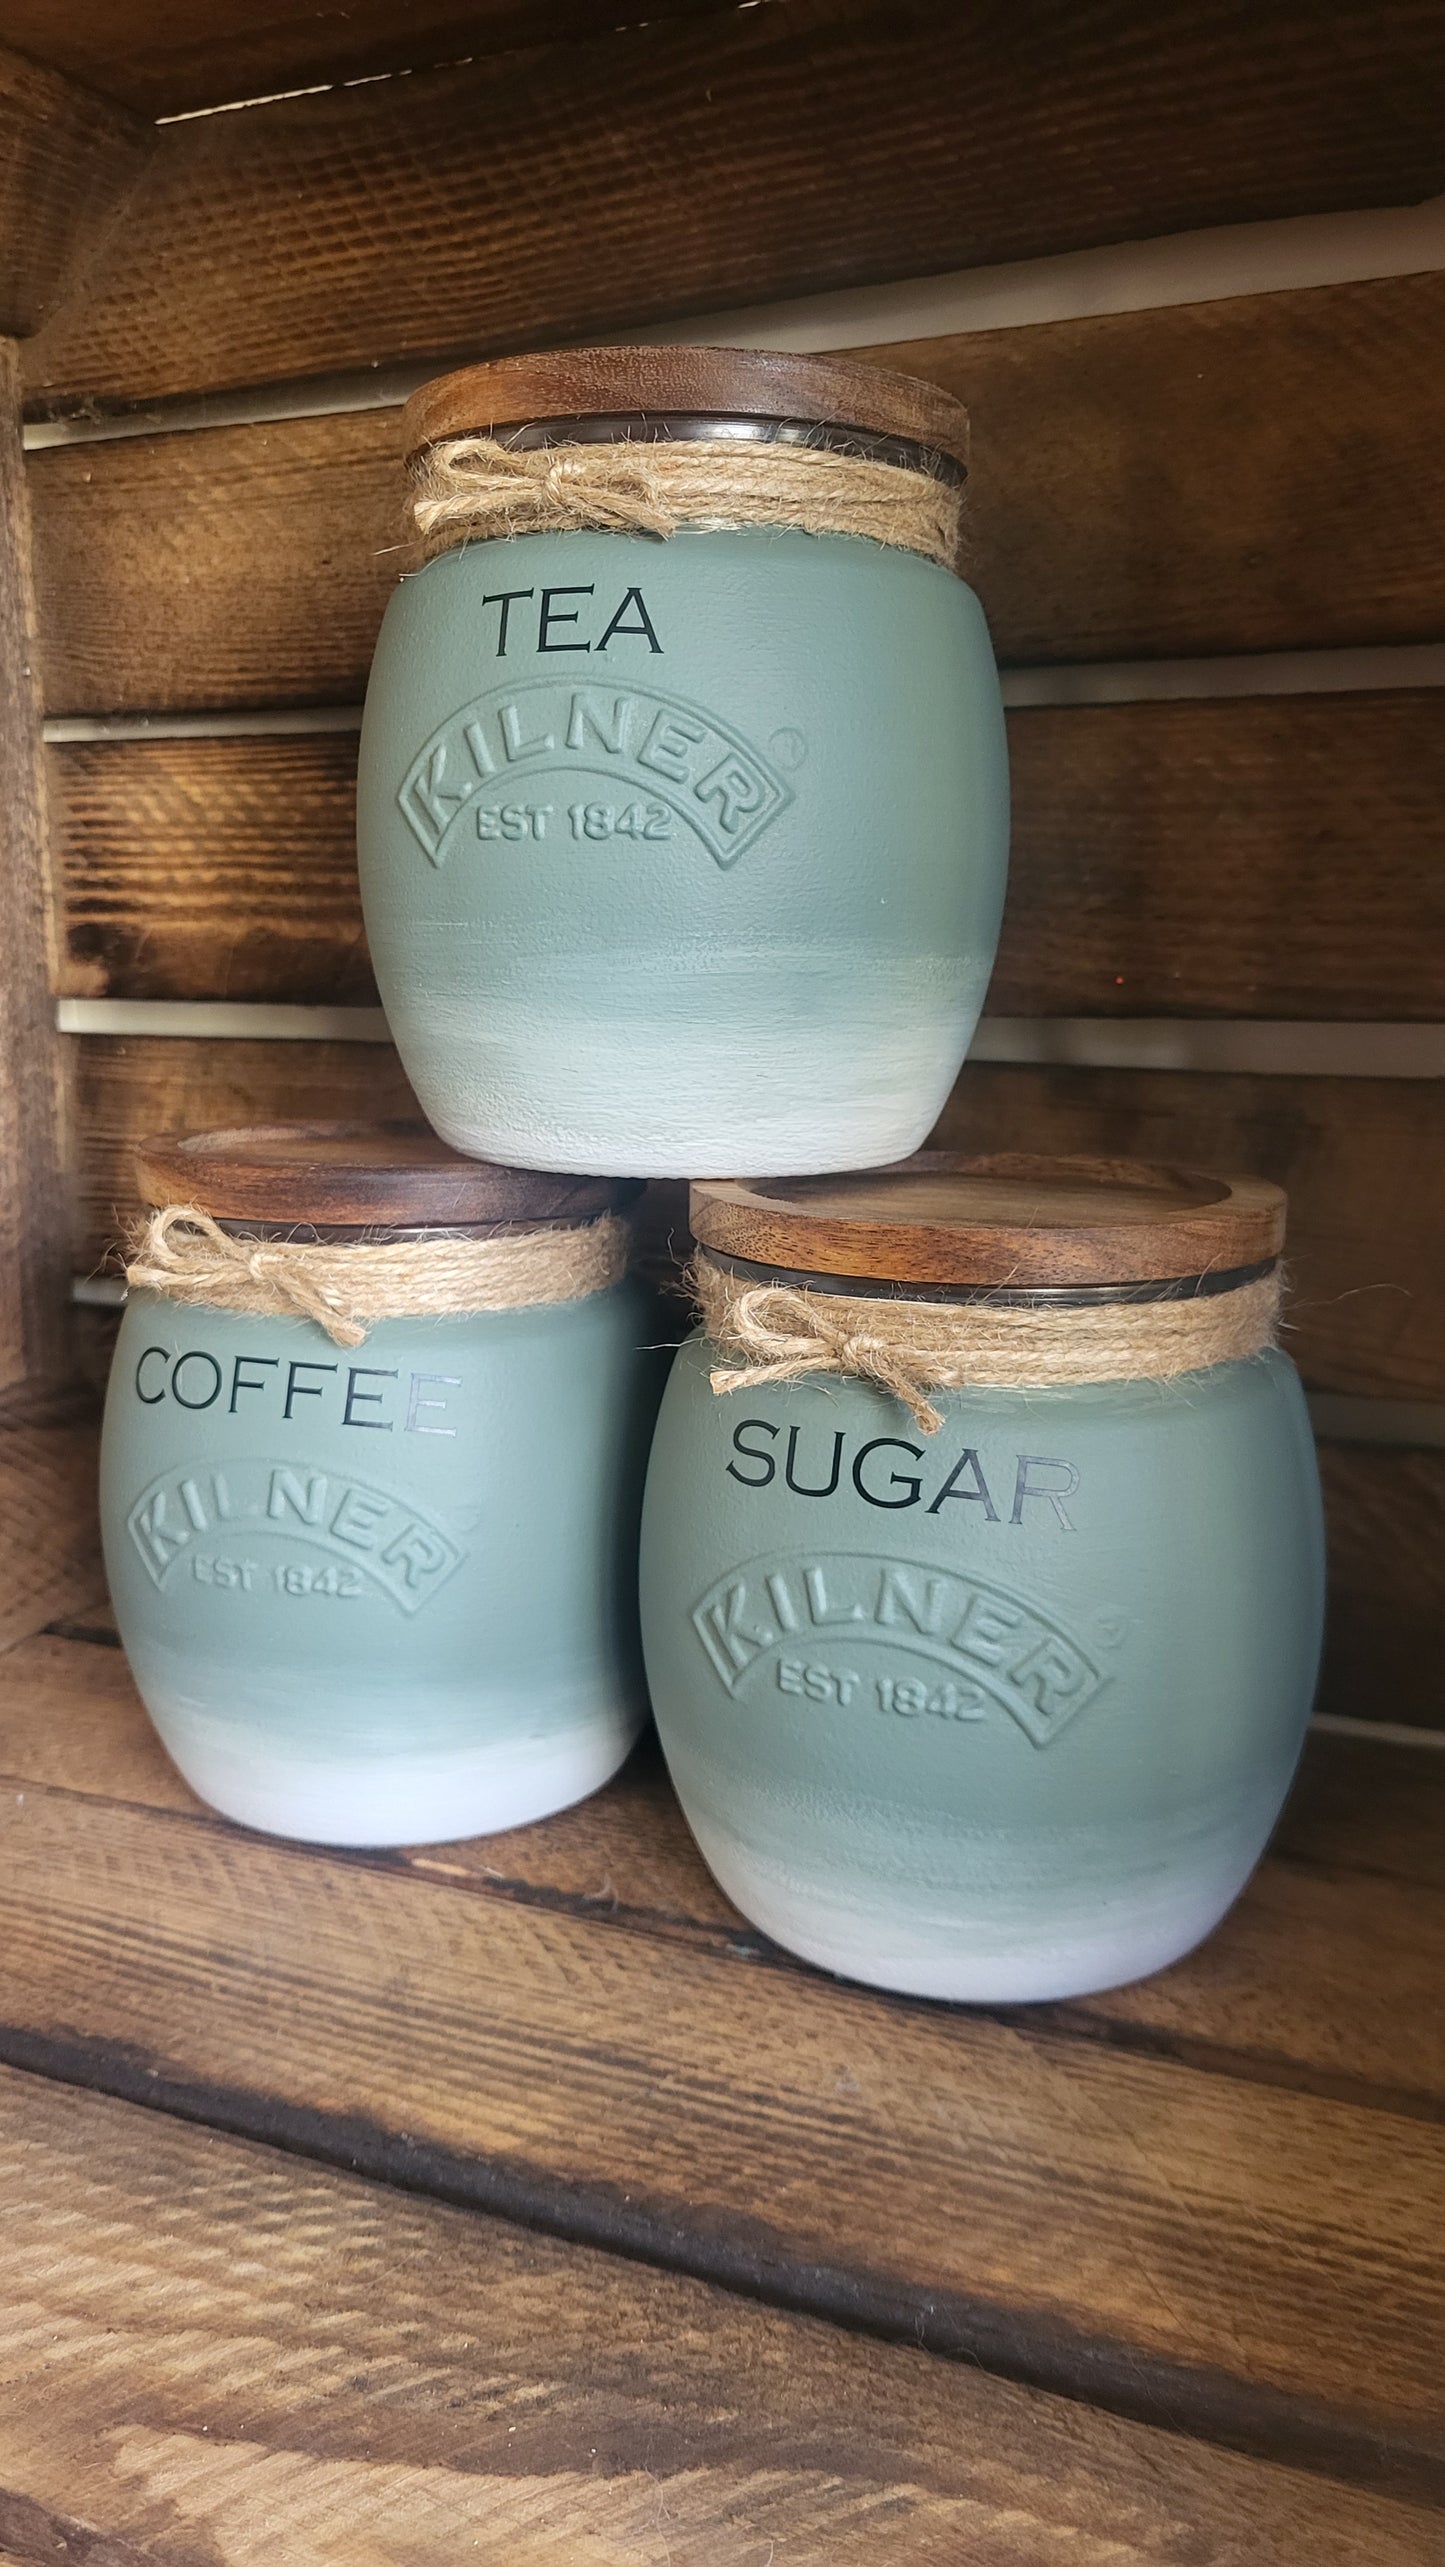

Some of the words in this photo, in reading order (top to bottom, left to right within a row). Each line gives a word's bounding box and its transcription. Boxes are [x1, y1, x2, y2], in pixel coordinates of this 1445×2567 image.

[482, 584, 664, 657] TEA
[412, 692, 766, 835] KILNER
[476, 805, 553, 841] EST
[567, 803, 673, 841] 1842
[135, 1345, 463, 1438] COFFEE
[725, 1419, 1081, 1531] SUGAR
[140, 1467, 447, 1589] KILNER
[193, 1555, 257, 1590] EST
[273, 1565, 364, 1597] 1842
[707, 1566, 1086, 1716] KILNER
[777, 1658, 860, 1706] EST
[876, 1676, 986, 1722] 1842
